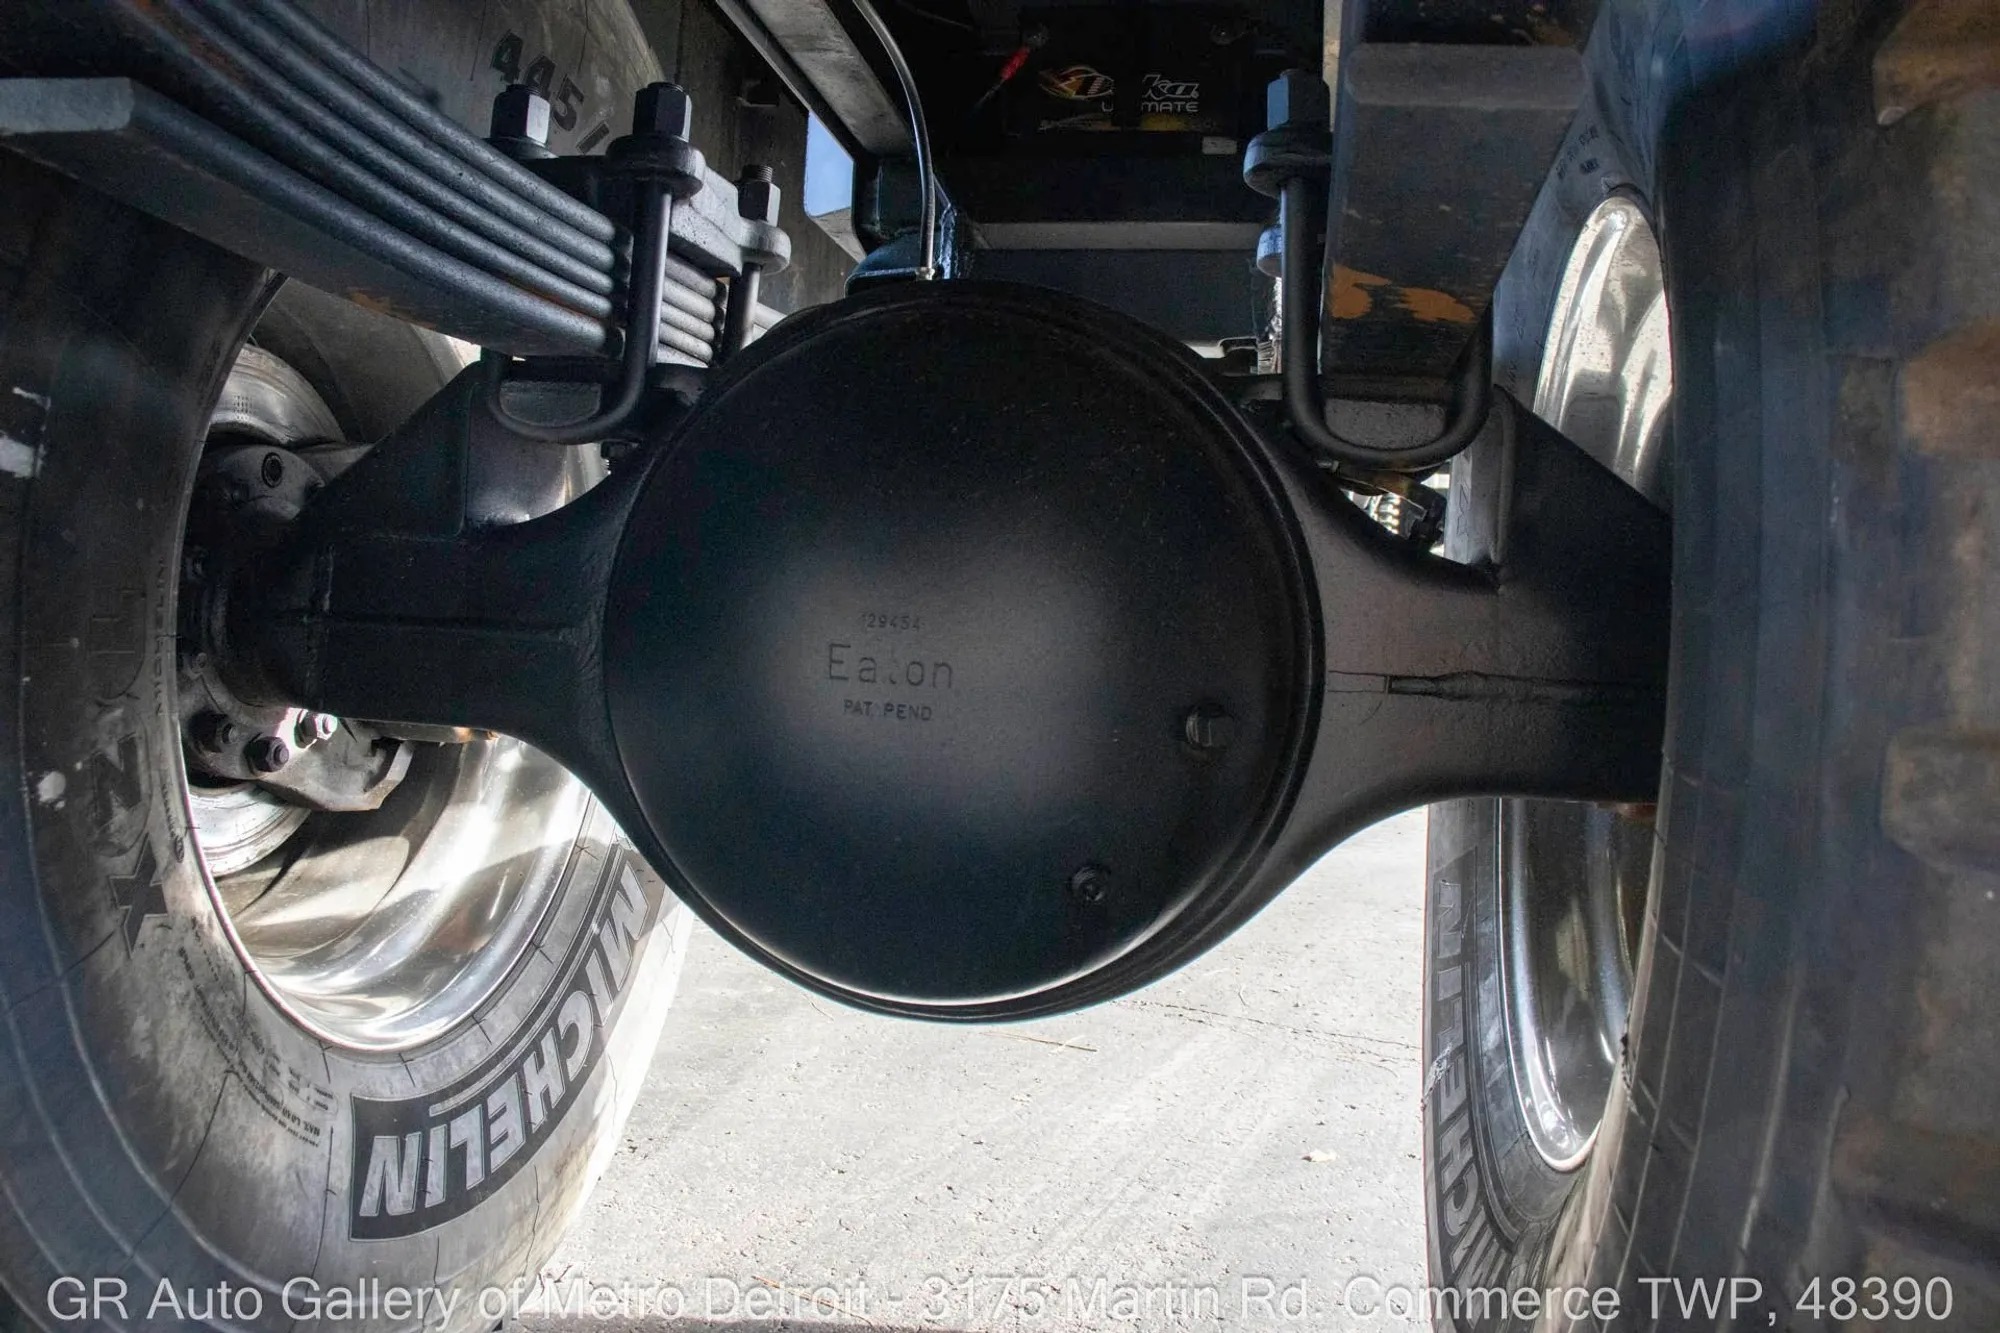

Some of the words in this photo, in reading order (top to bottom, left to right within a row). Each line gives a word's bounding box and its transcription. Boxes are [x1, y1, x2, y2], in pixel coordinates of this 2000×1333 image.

[843, 698, 873, 717] PAT
[882, 701, 933, 722] PEND
[359, 859, 649, 1218] MICHELIN
